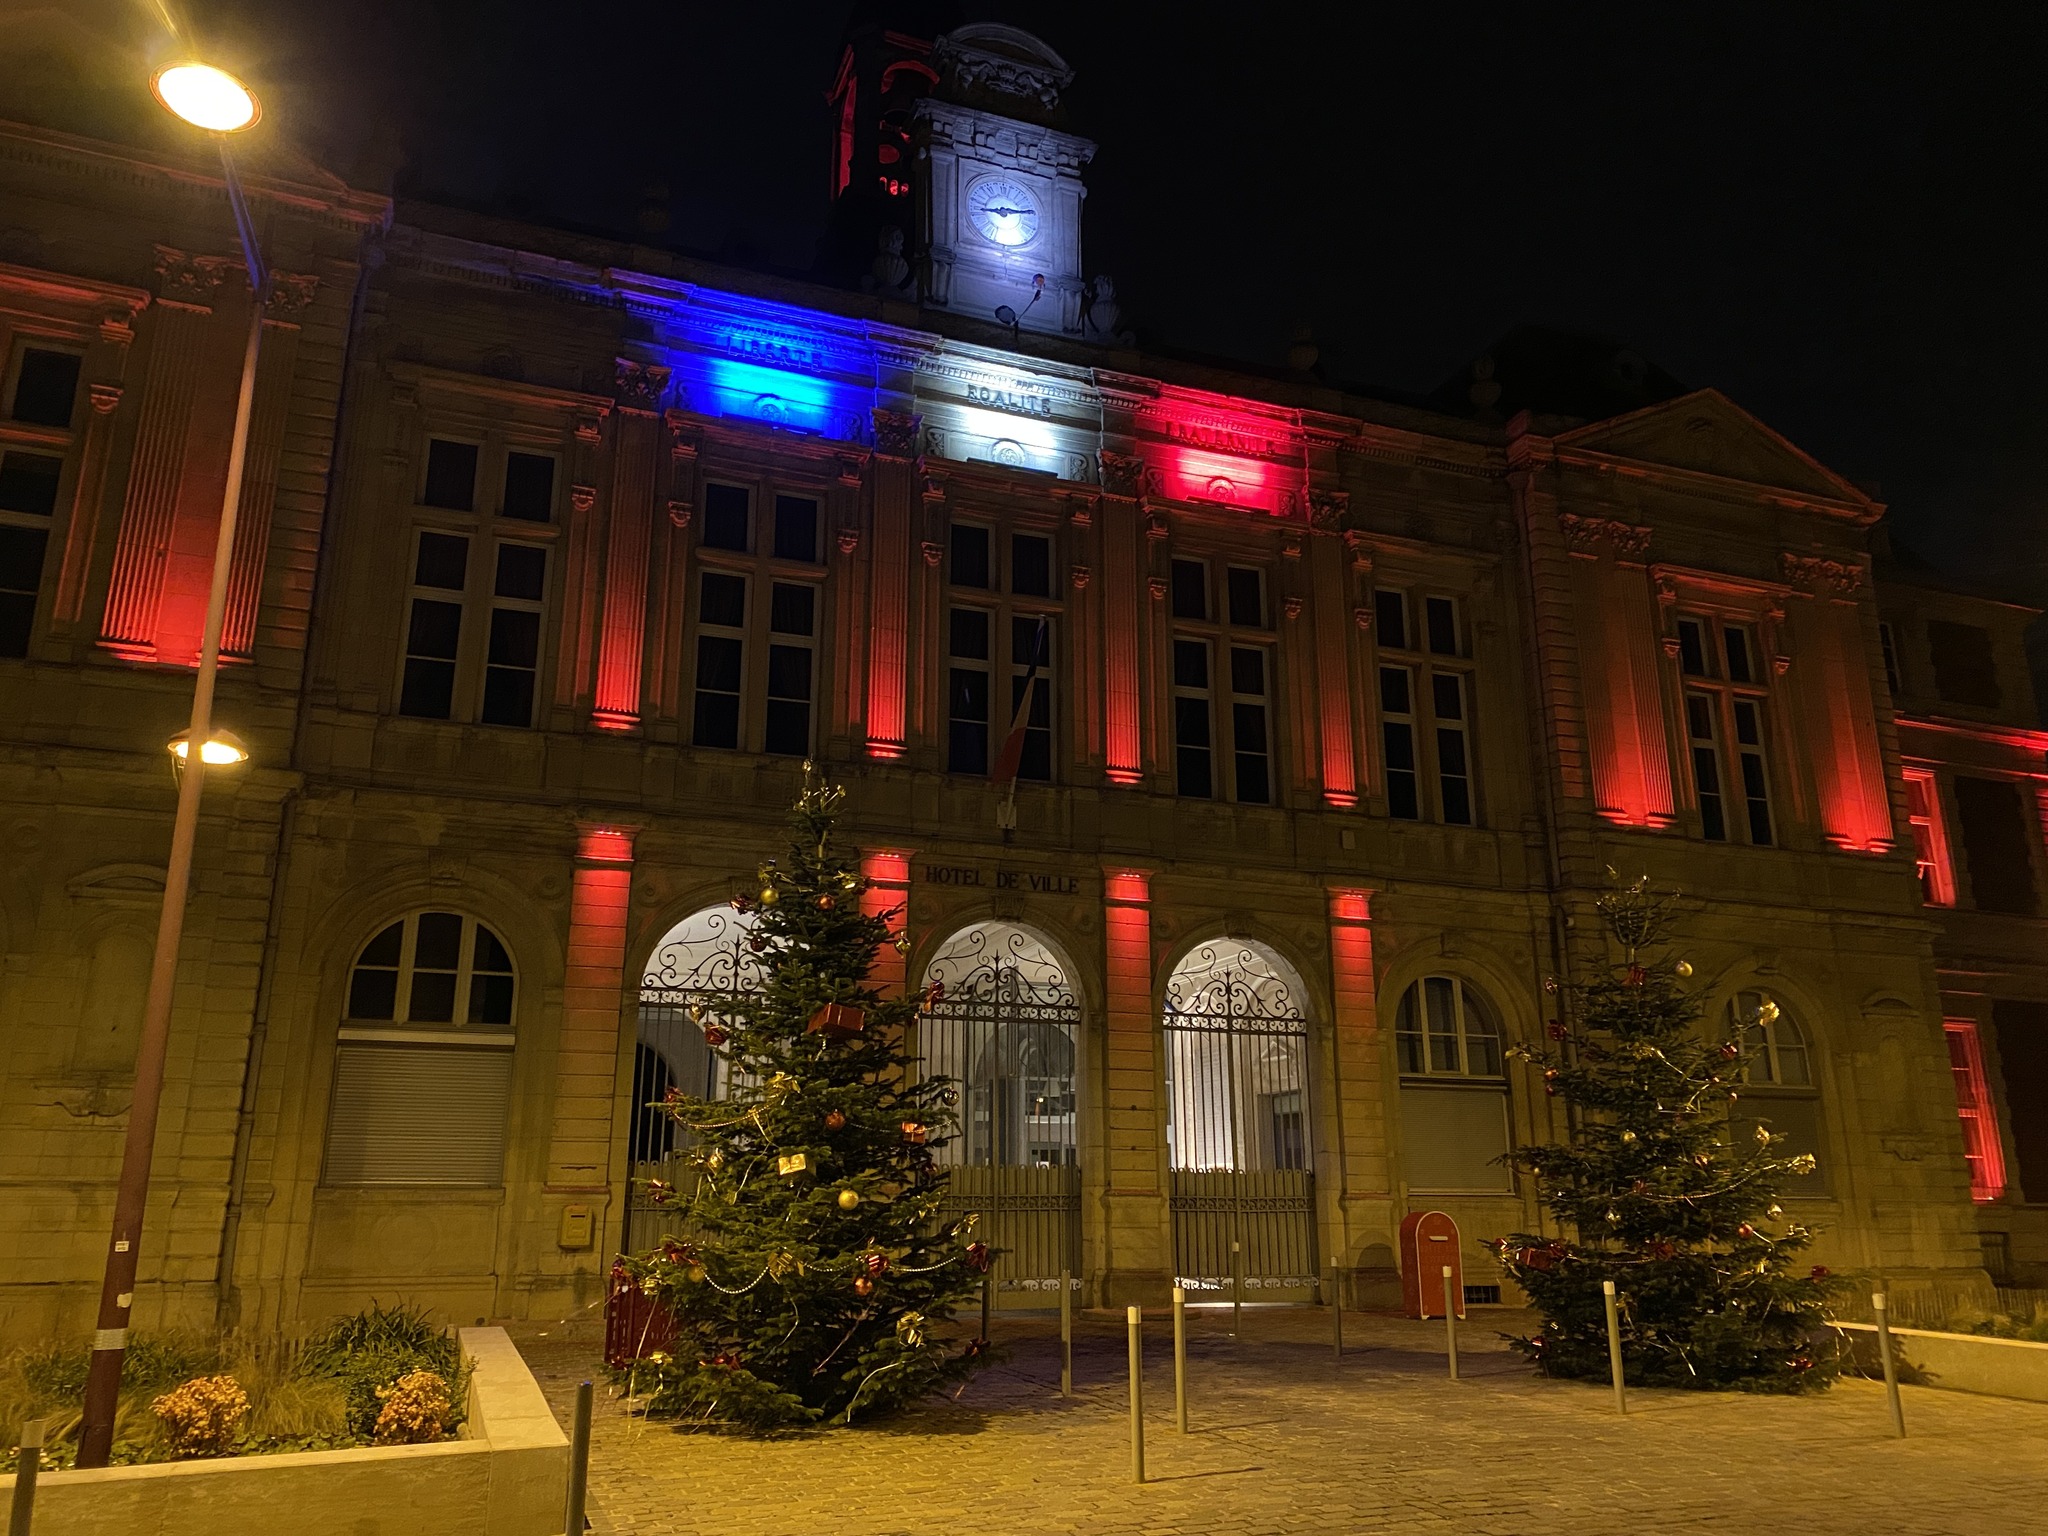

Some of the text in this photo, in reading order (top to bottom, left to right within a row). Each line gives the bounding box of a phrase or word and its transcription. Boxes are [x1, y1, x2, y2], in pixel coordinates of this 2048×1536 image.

[925, 866, 1080, 894] HOTEL DE VILLE
